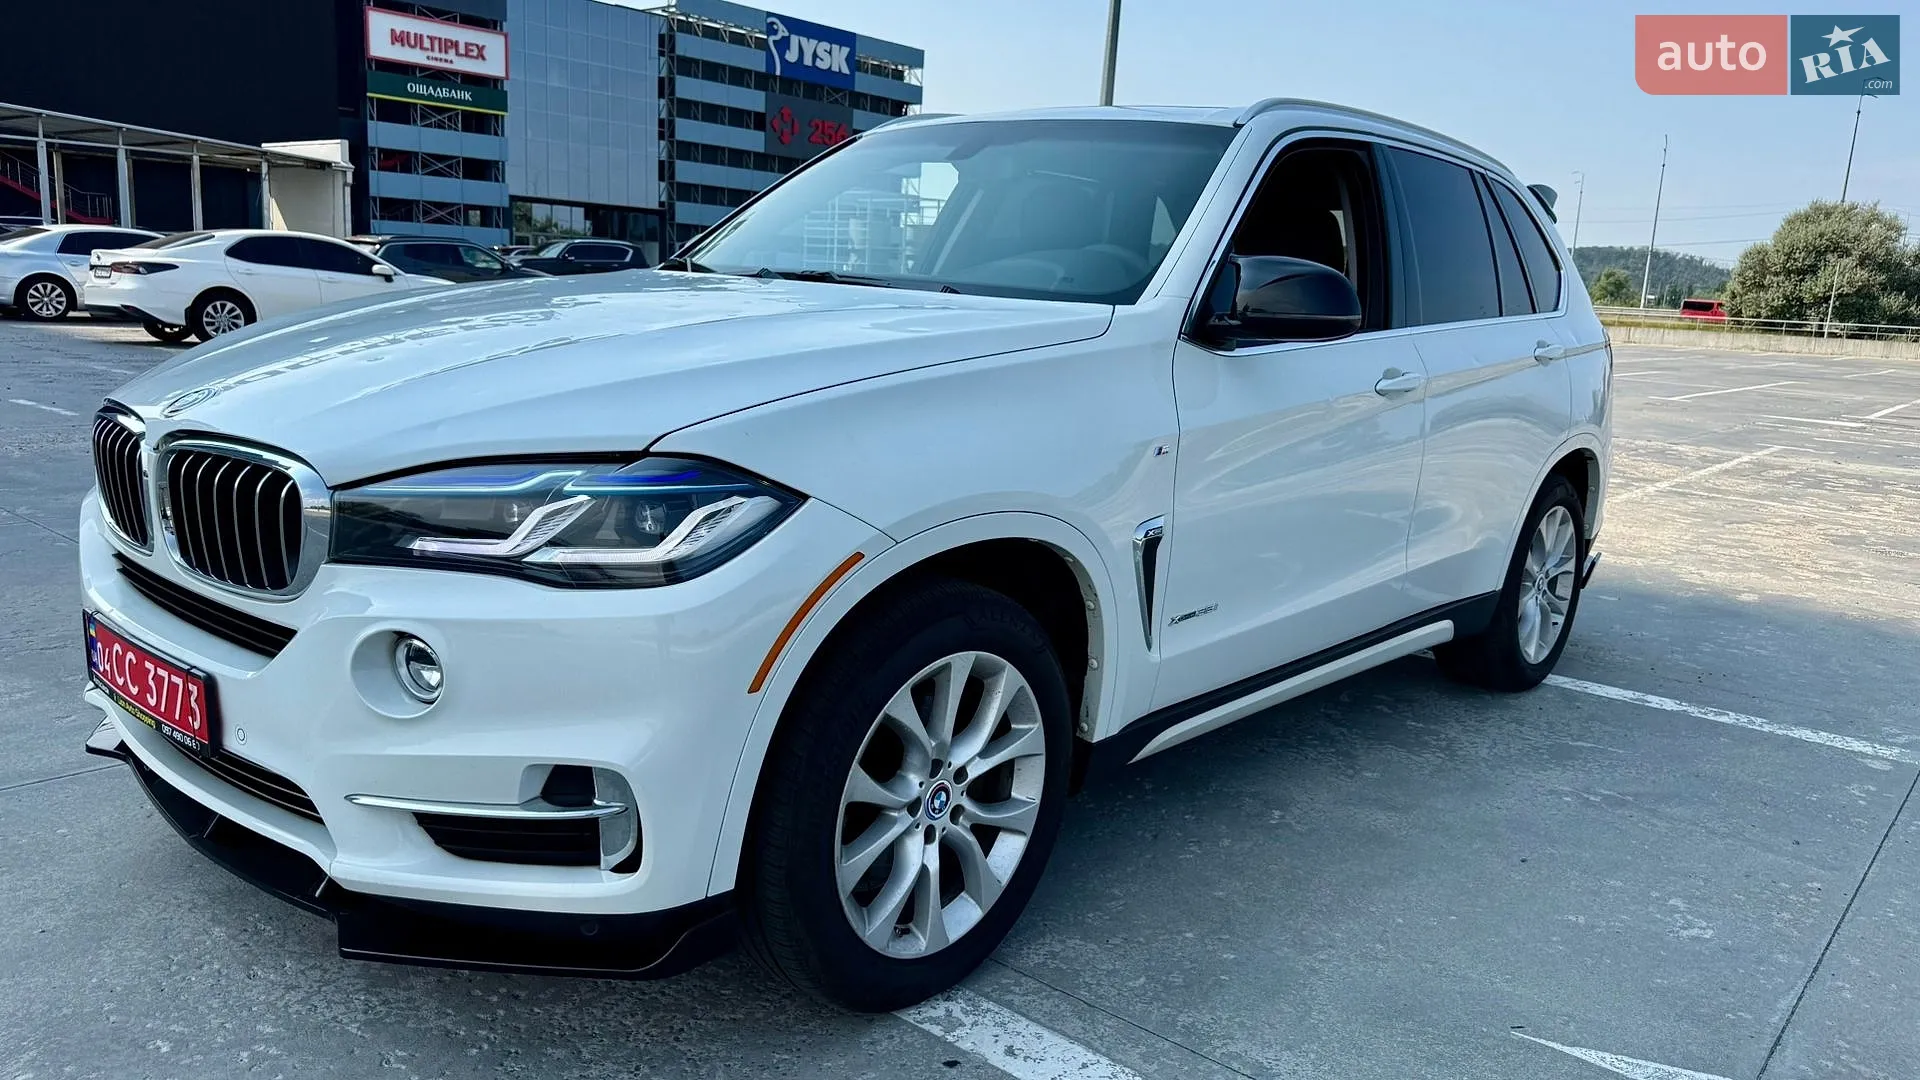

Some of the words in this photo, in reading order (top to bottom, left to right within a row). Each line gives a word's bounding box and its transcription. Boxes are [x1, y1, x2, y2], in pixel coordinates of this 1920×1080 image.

[390, 28, 486, 61] MULTIPLEX
[426, 55, 454, 64] CINEMA
[785, 34, 851, 75] JYSK
[407, 82, 473, 102] ОЩАДБАНК
[808, 118, 849, 145] 256
[144, 661, 201, 730] 3773
